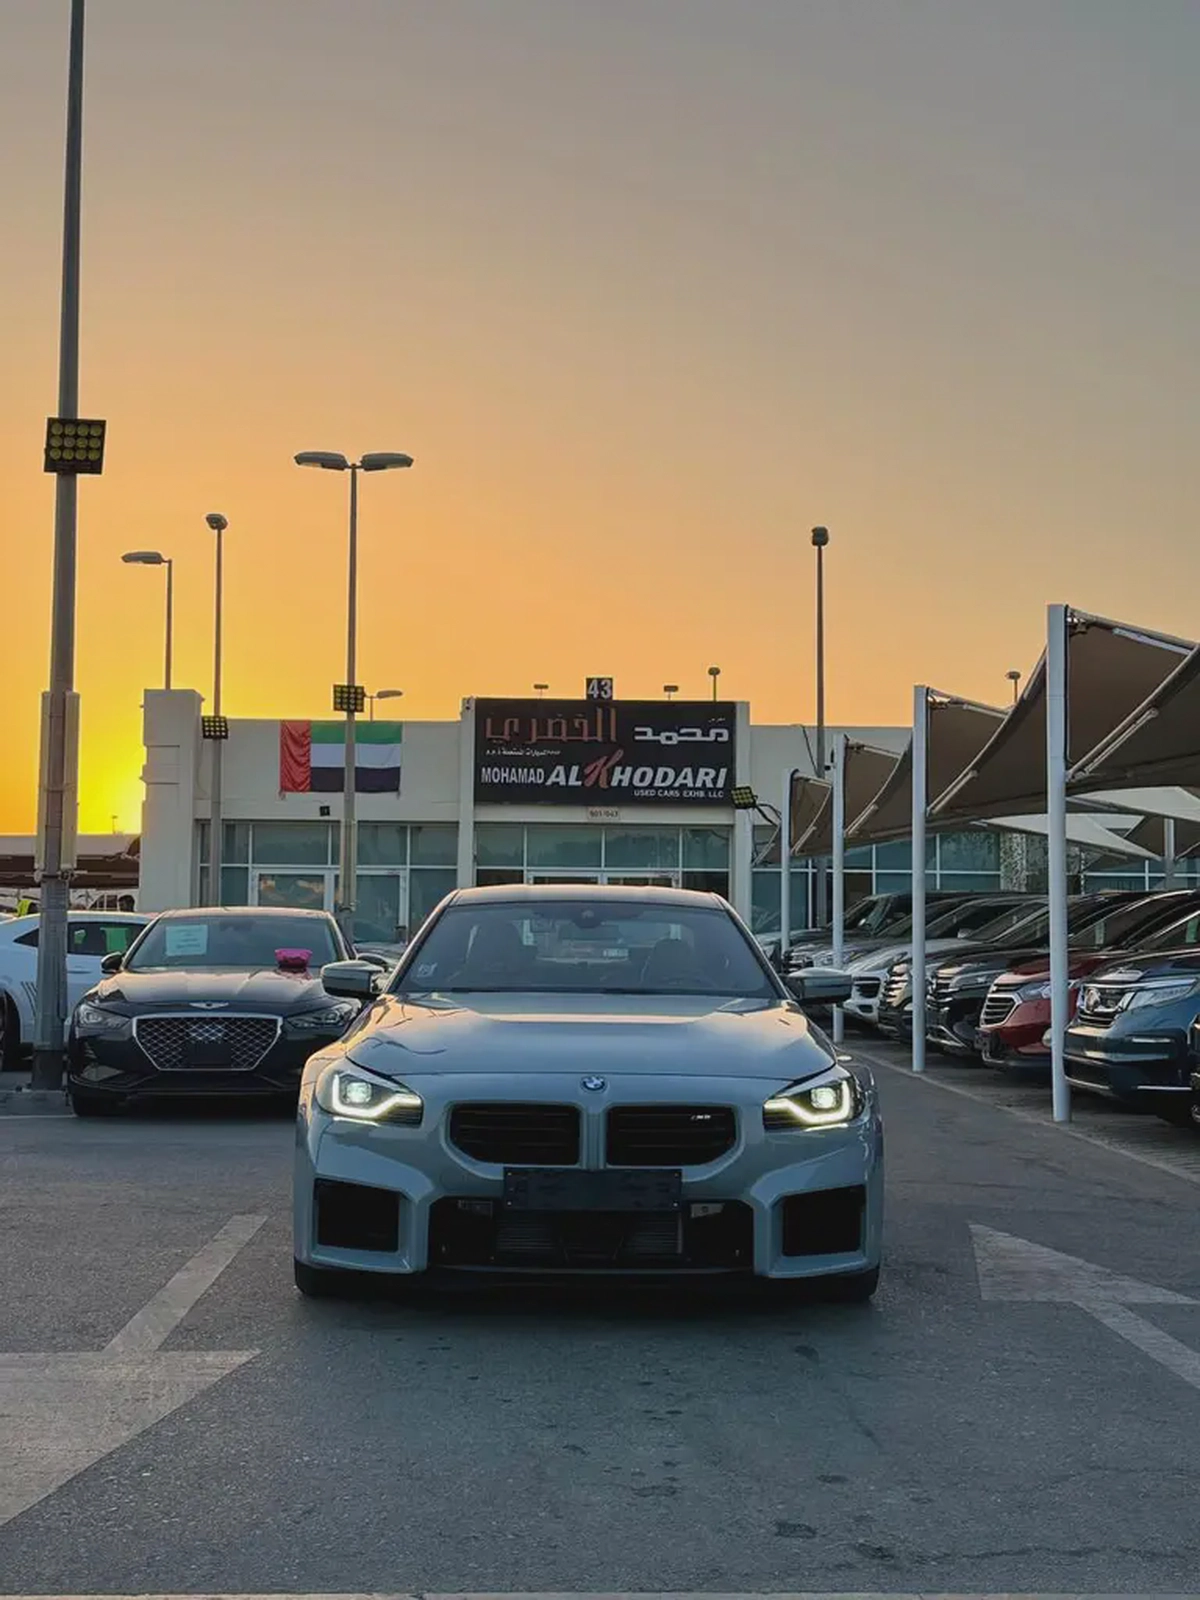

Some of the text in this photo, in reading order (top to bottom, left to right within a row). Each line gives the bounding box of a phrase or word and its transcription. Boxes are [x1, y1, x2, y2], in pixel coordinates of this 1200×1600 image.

[587, 679, 613, 699] 43
[634, 726, 729, 745] محمد
[481, 766, 545, 784] MOHAMAD
[633, 788, 656, 797] USED
[657, 788, 681, 798] CARS
[708, 790, 725, 798] LLC
